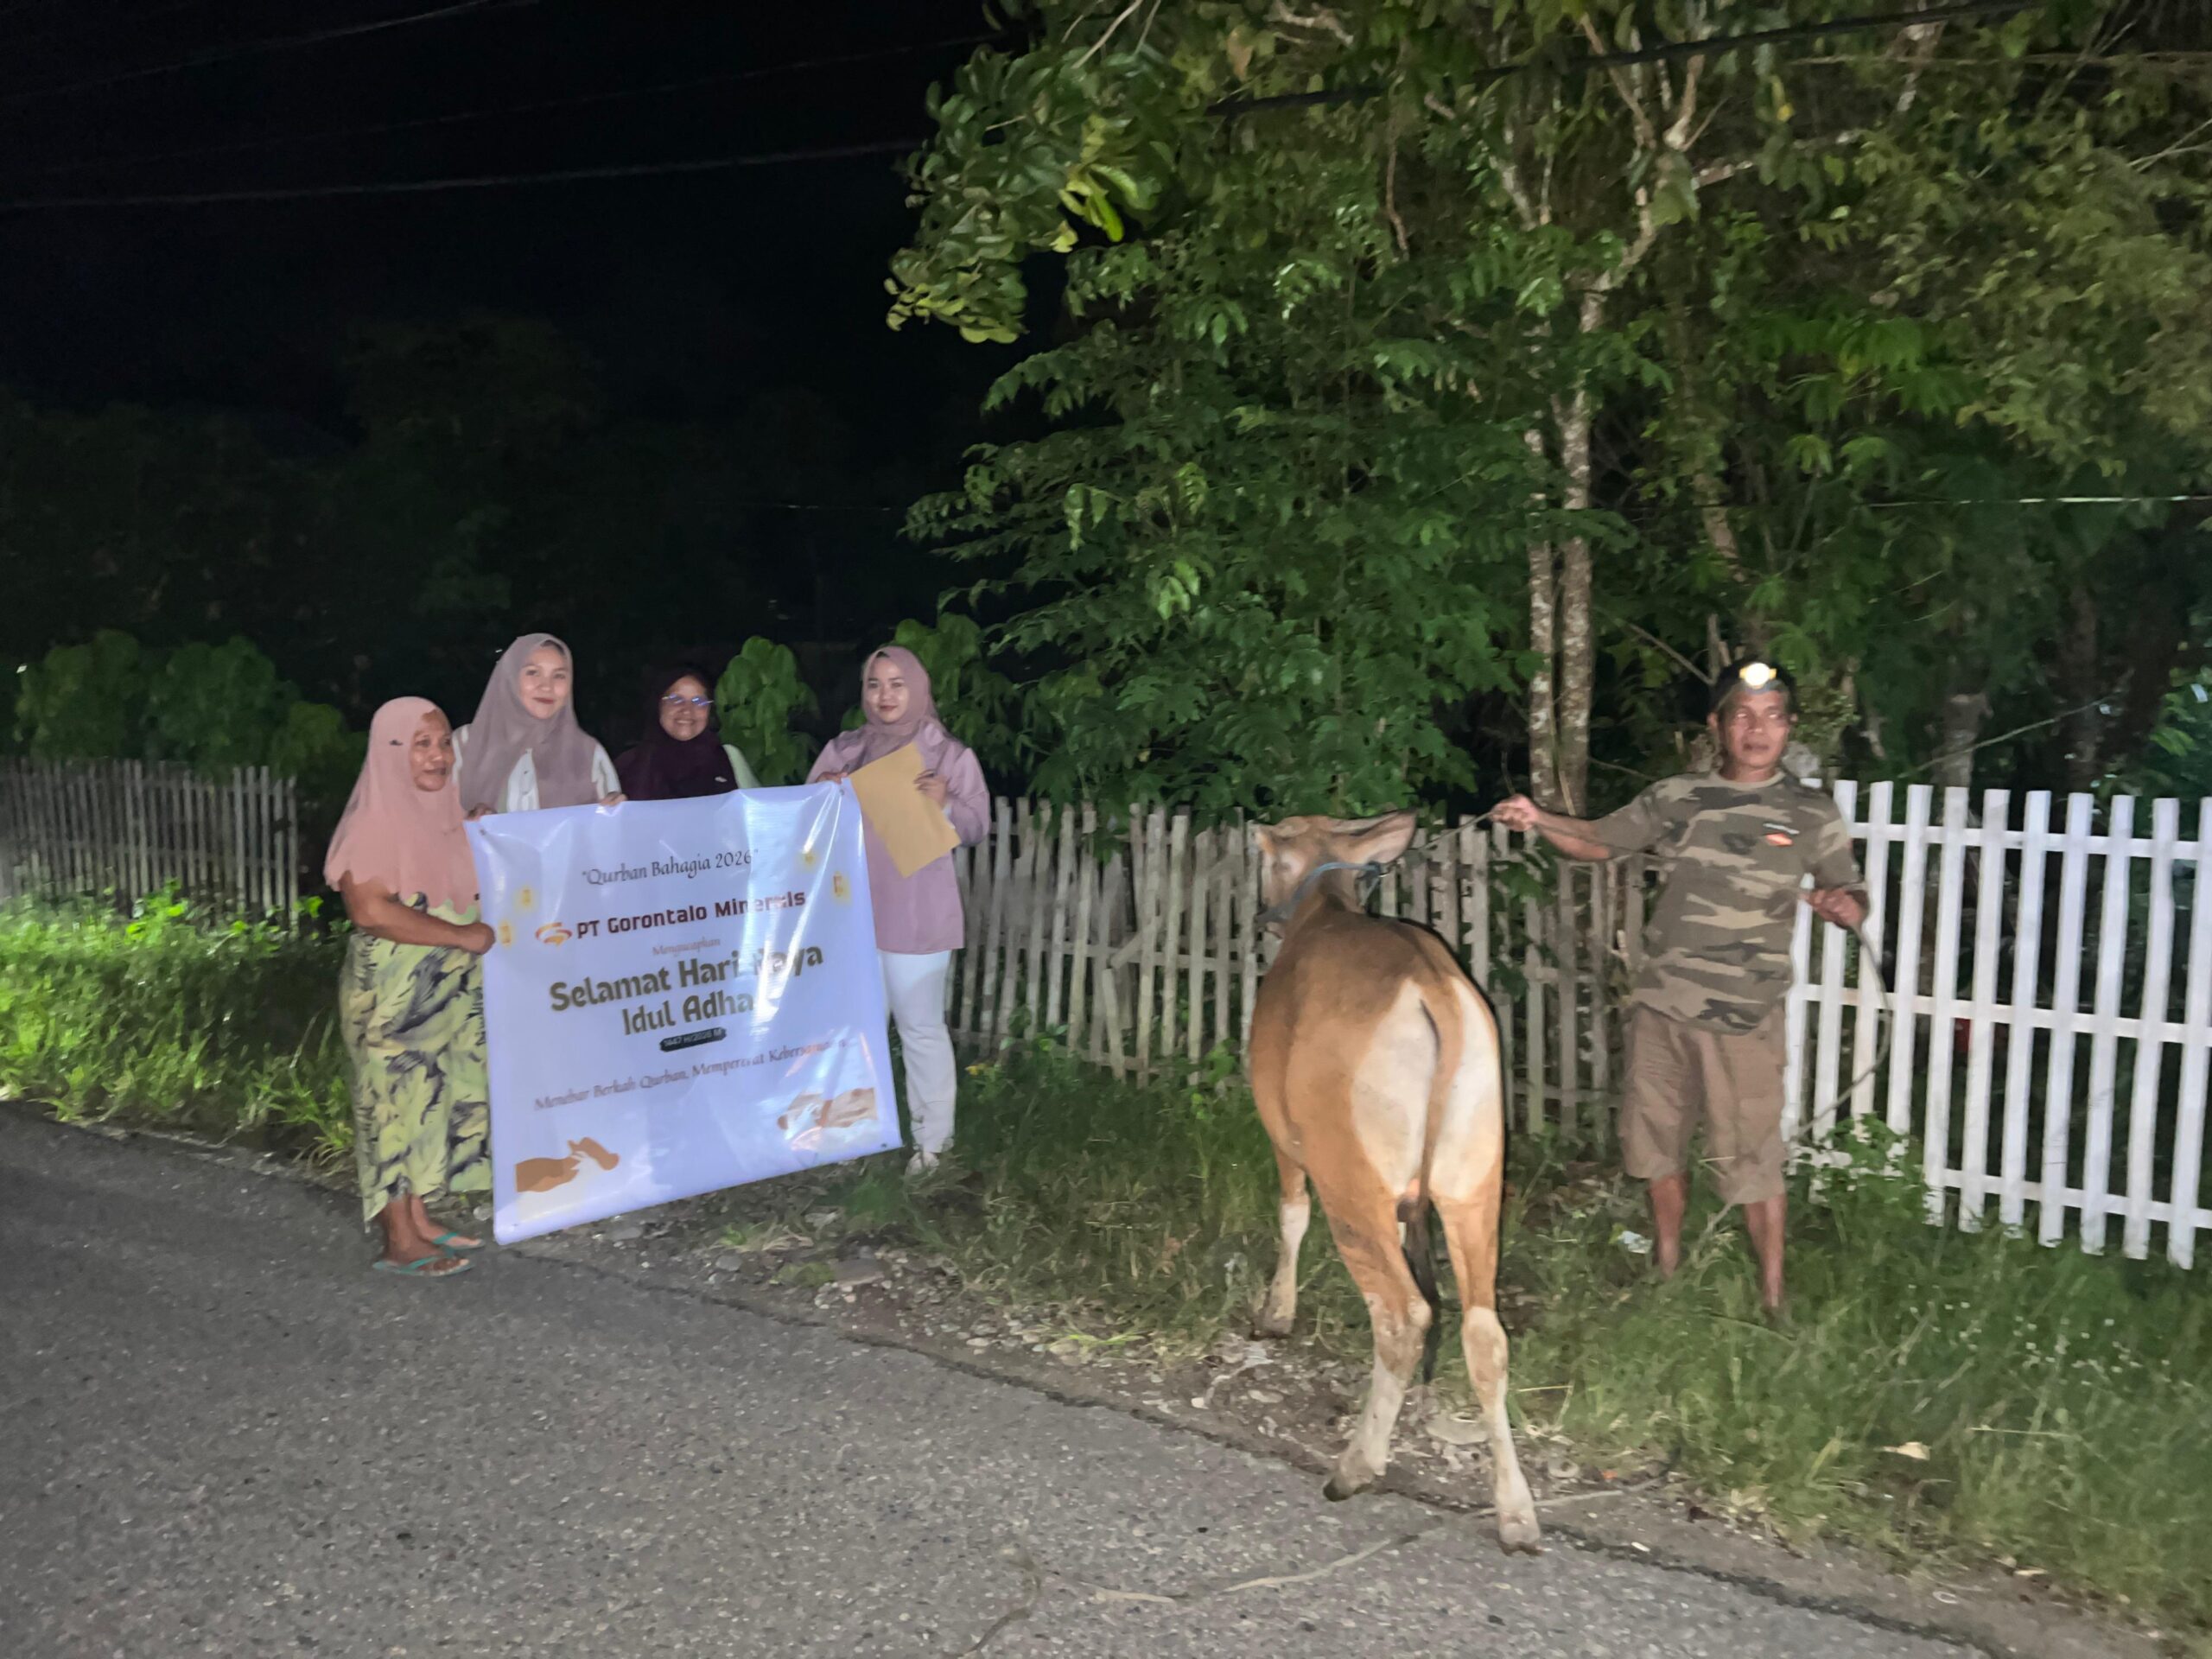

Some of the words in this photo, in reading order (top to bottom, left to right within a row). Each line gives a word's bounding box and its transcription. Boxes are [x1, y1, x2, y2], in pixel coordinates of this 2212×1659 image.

[652, 854, 711, 879] Bahagia
[577, 920, 600, 939] PT
[607, 905, 707, 933] Gorontalo
[550, 967, 671, 1012] Selamat
[678, 950, 739, 988] Hari
[621, 1001, 677, 1035] Idul
[683, 989, 753, 1023] Adha
